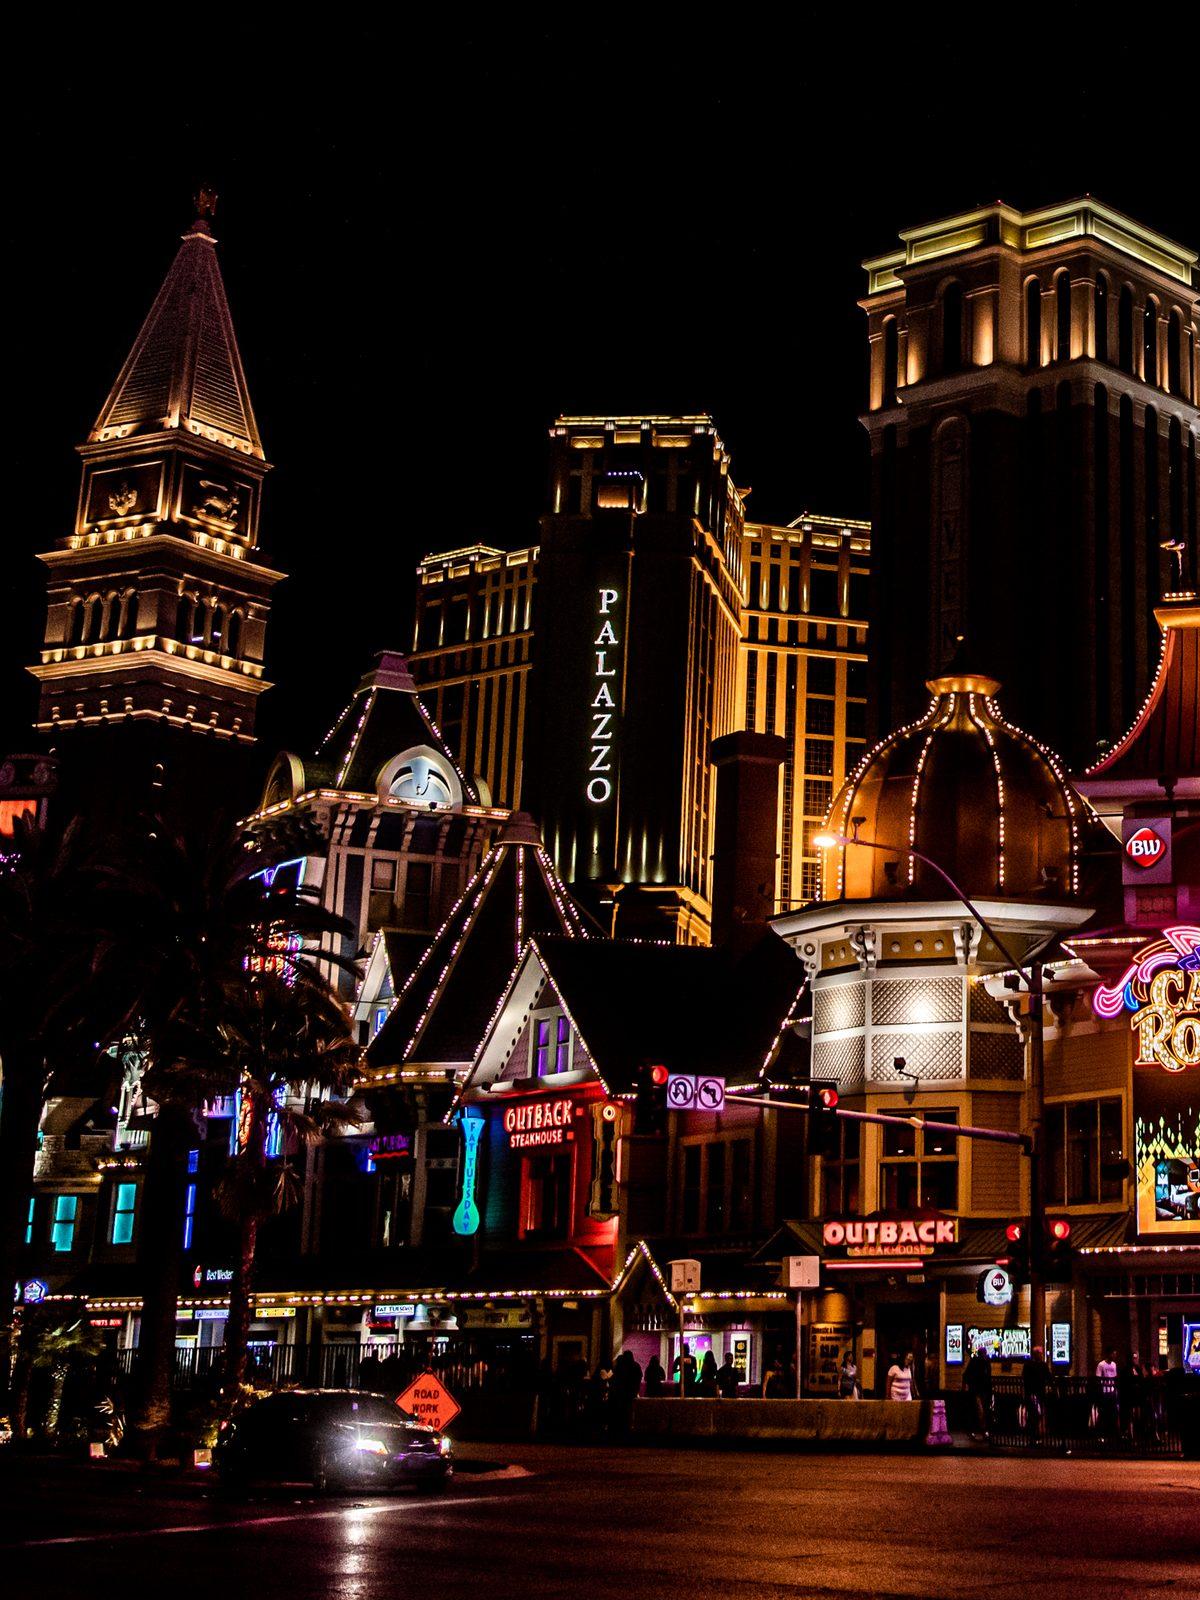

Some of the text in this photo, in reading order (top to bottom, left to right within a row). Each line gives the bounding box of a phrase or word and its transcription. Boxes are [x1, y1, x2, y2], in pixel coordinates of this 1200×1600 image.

[586, 588, 619, 803] PALAZZO
[1131, 839, 1160, 855] BW
[505, 1101, 572, 1131] OUTBACK
[510, 1131, 562, 1148] STEAKHOUSE
[823, 1220, 955, 1245] OUTBACK
[853, 1245, 927, 1256] STEAKHOUSE
[413, 1389, 440, 1399] ROAD
[412, 1403, 439, 1413] WORK
